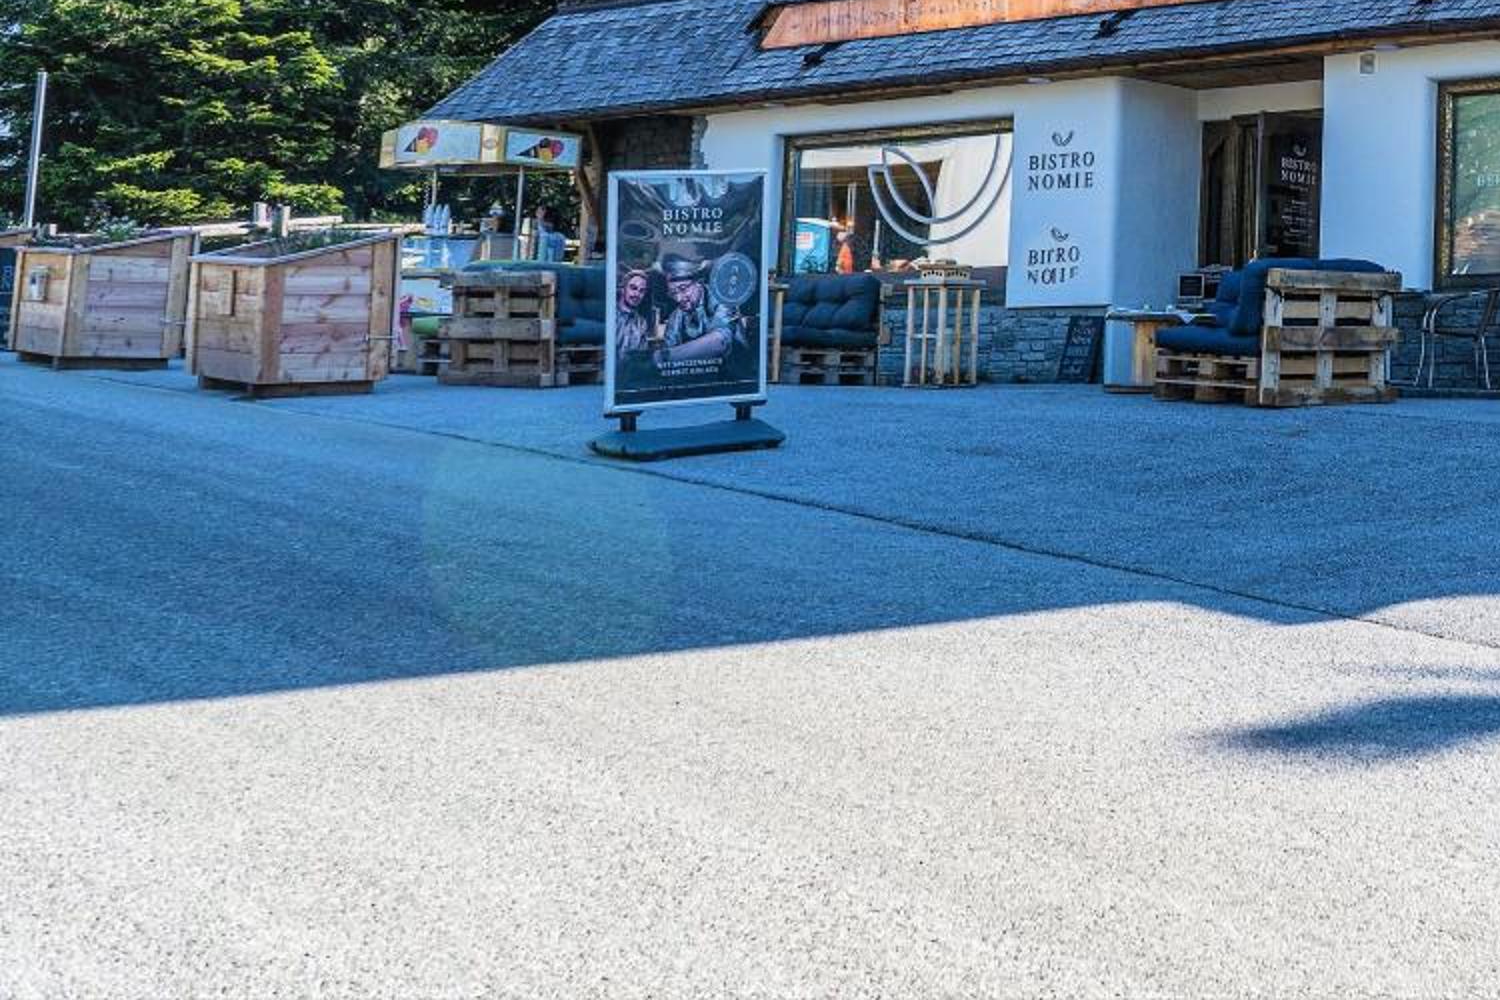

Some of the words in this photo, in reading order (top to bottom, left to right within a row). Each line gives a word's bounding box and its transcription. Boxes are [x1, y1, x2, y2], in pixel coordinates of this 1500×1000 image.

[1028, 151, 1095, 171] BISTRO
[1027, 171, 1094, 191] NOMIE
[663, 207, 723, 221] BISTRO
